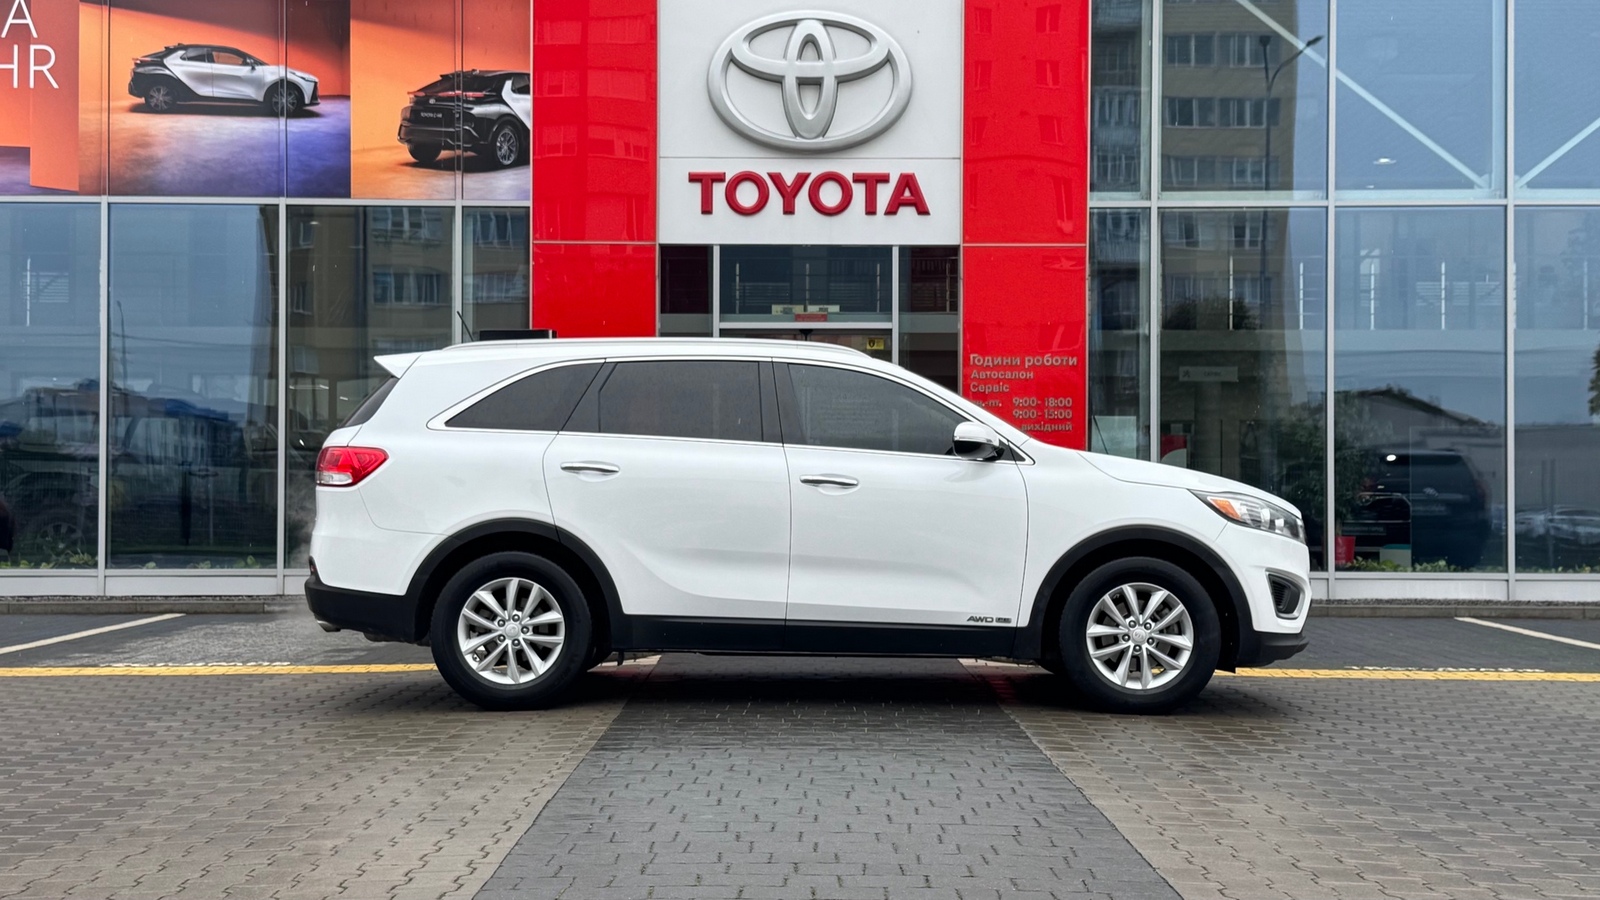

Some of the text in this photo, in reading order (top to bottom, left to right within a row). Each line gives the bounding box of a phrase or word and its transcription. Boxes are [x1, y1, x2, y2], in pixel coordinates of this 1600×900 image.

[688, 171, 931, 217] TOYOTA
[970, 353, 1077, 368] Години роботи
[971, 370, 1034, 379] Автосалон
[970, 382, 1010, 393] Сервіс
[966, 615, 994, 623] AWD
